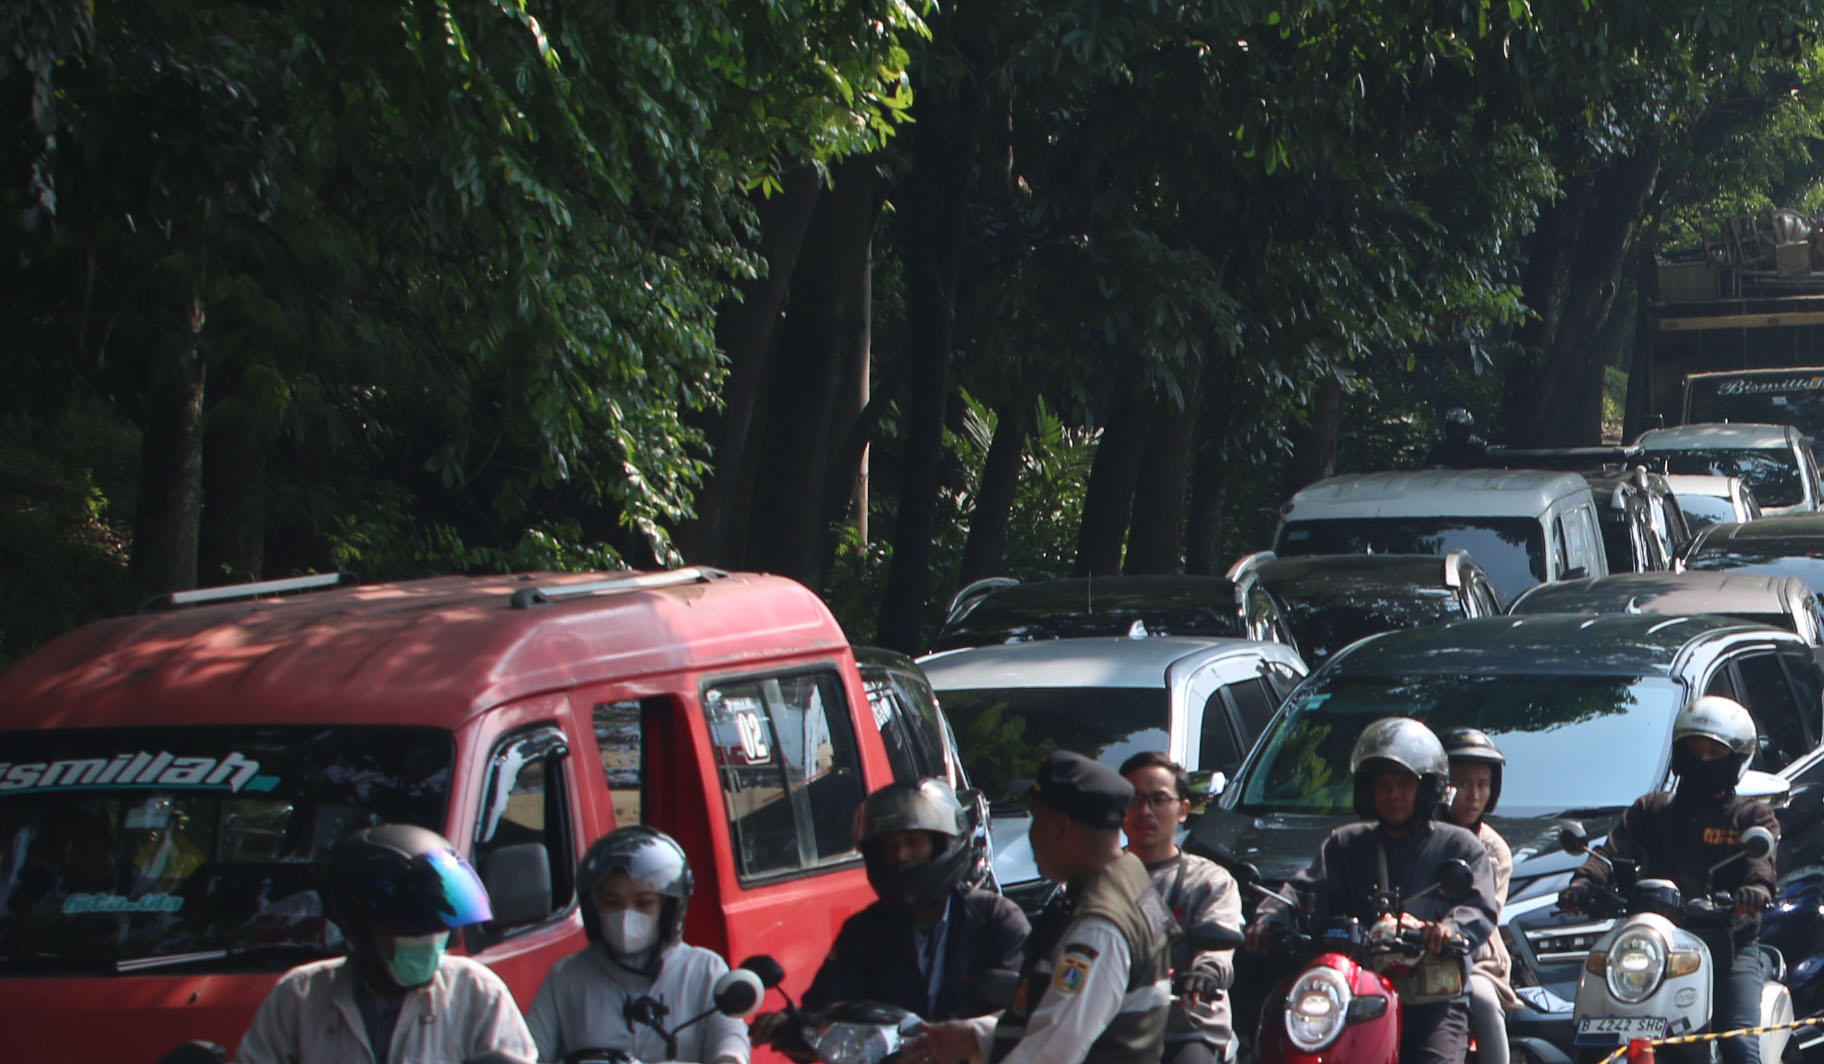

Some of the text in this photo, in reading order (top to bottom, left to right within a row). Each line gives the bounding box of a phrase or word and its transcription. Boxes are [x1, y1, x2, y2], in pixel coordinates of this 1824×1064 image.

[1582, 1020, 1663, 1031] B 4242 SHG
